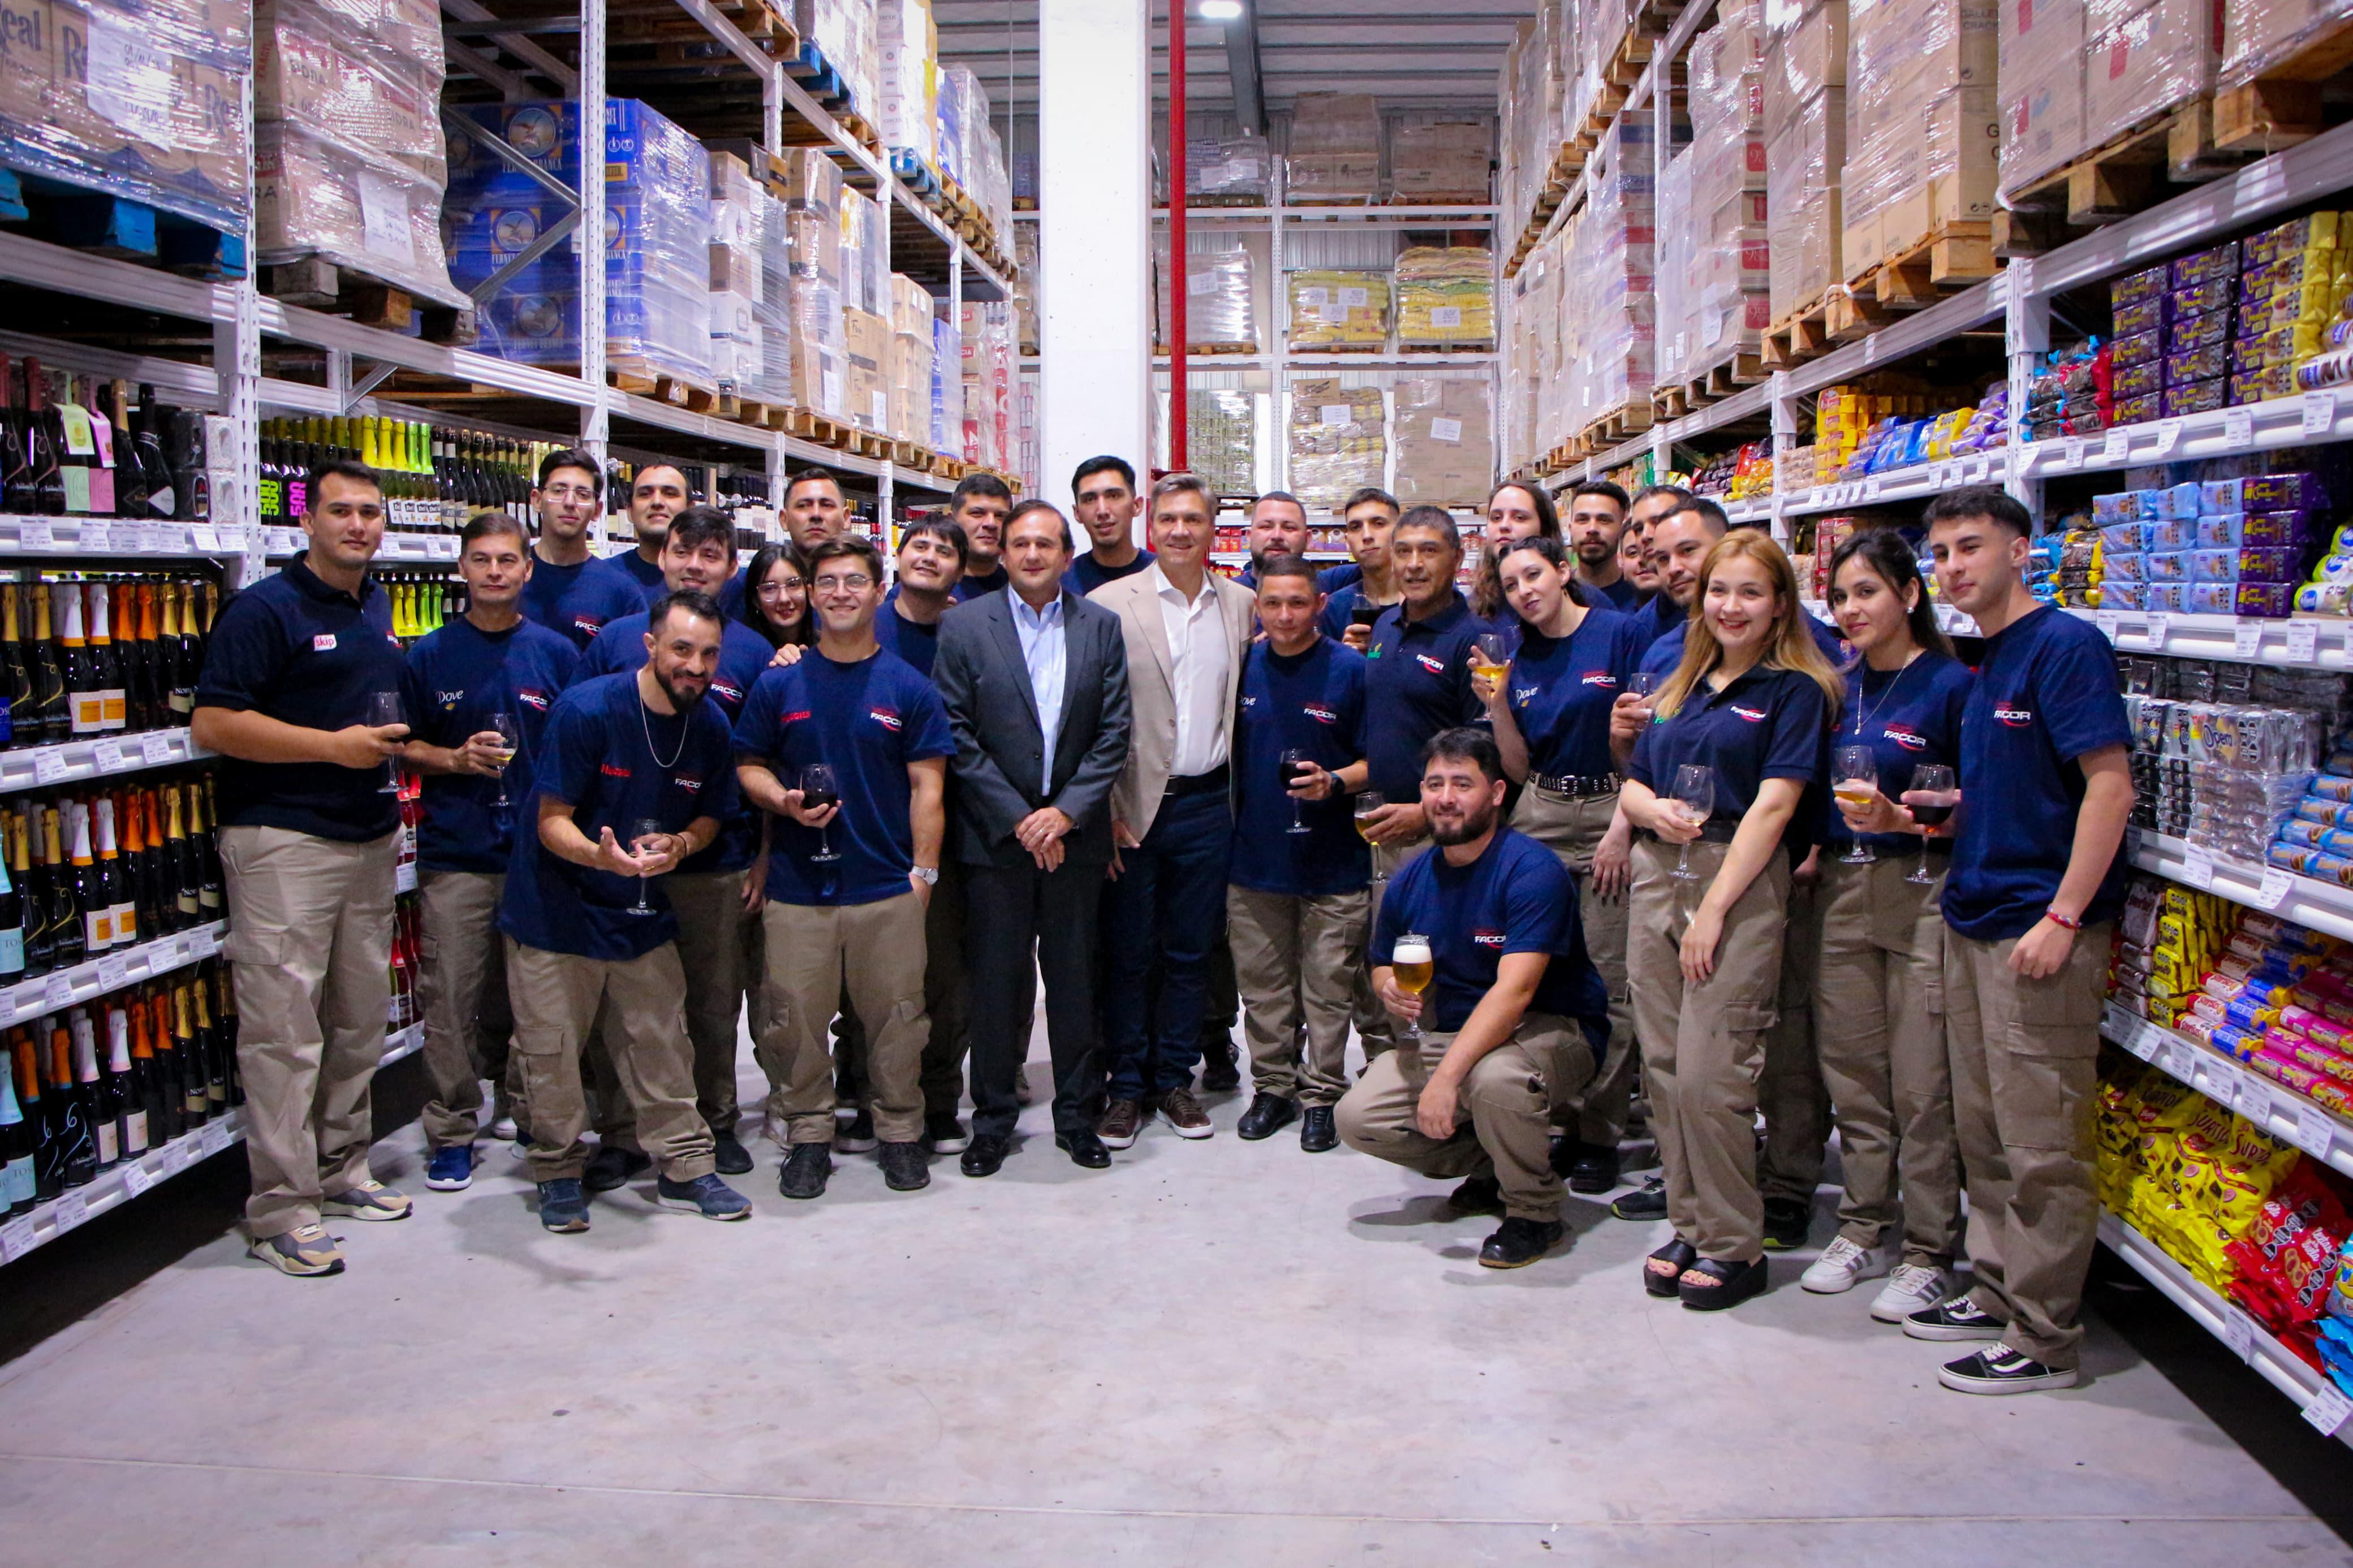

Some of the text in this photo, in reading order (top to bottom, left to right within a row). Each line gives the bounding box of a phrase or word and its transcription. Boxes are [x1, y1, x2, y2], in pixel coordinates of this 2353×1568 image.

[0, 8, 41, 51] eal
[575, 620, 600, 632] FACO
[316, 637, 334, 648] skip
[1416, 654, 1443, 670] FACOR
[1581, 676, 1615, 685] FACOR
[435, 689, 464, 705] Dove
[1515, 686, 1537, 703] Dove
[1240, 696, 1256, 706] ove
[1303, 708, 1336, 719] FACOR
[1882, 730, 1926, 746] FACOR
[675, 777, 701, 789] FACO
[1474, 935, 1506, 943] FACO
